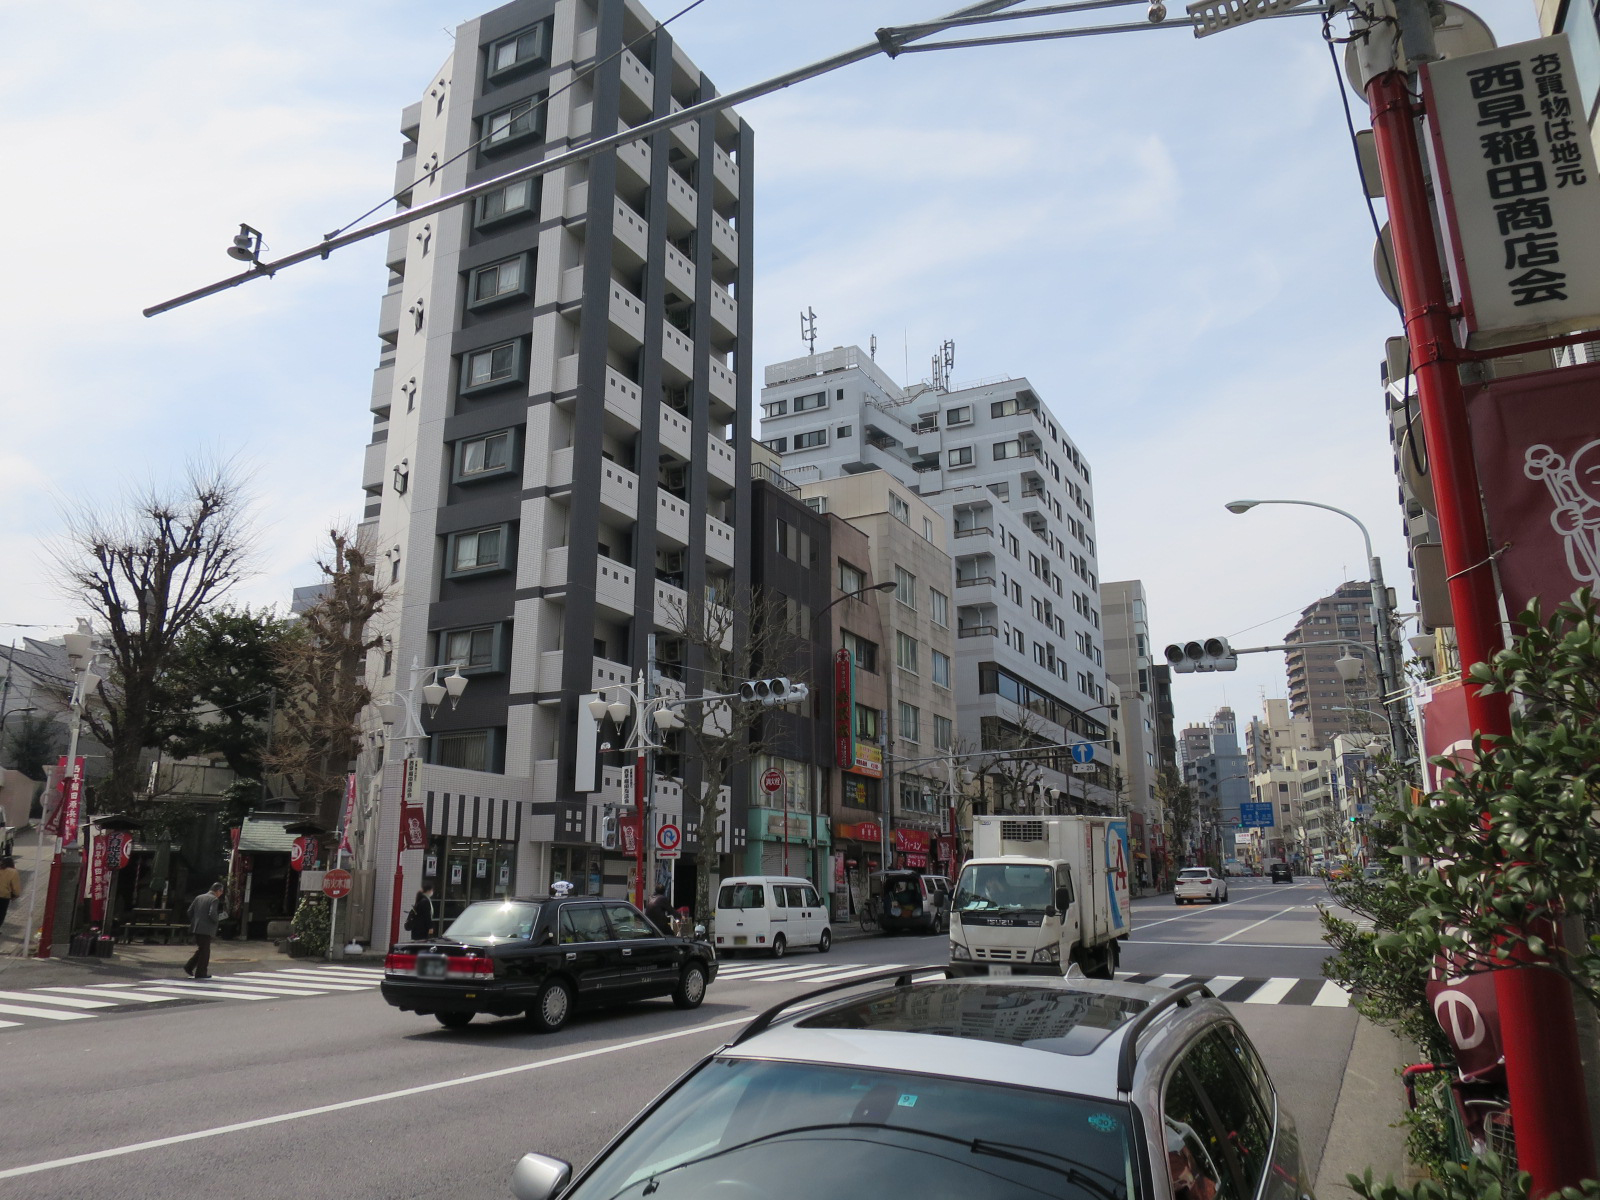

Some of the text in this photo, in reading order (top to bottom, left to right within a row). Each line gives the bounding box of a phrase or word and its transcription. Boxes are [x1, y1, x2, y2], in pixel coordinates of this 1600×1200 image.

[1466, 60, 1568, 306] 西早稲田商店会
[1530, 53, 1587, 189] お買物は地元
